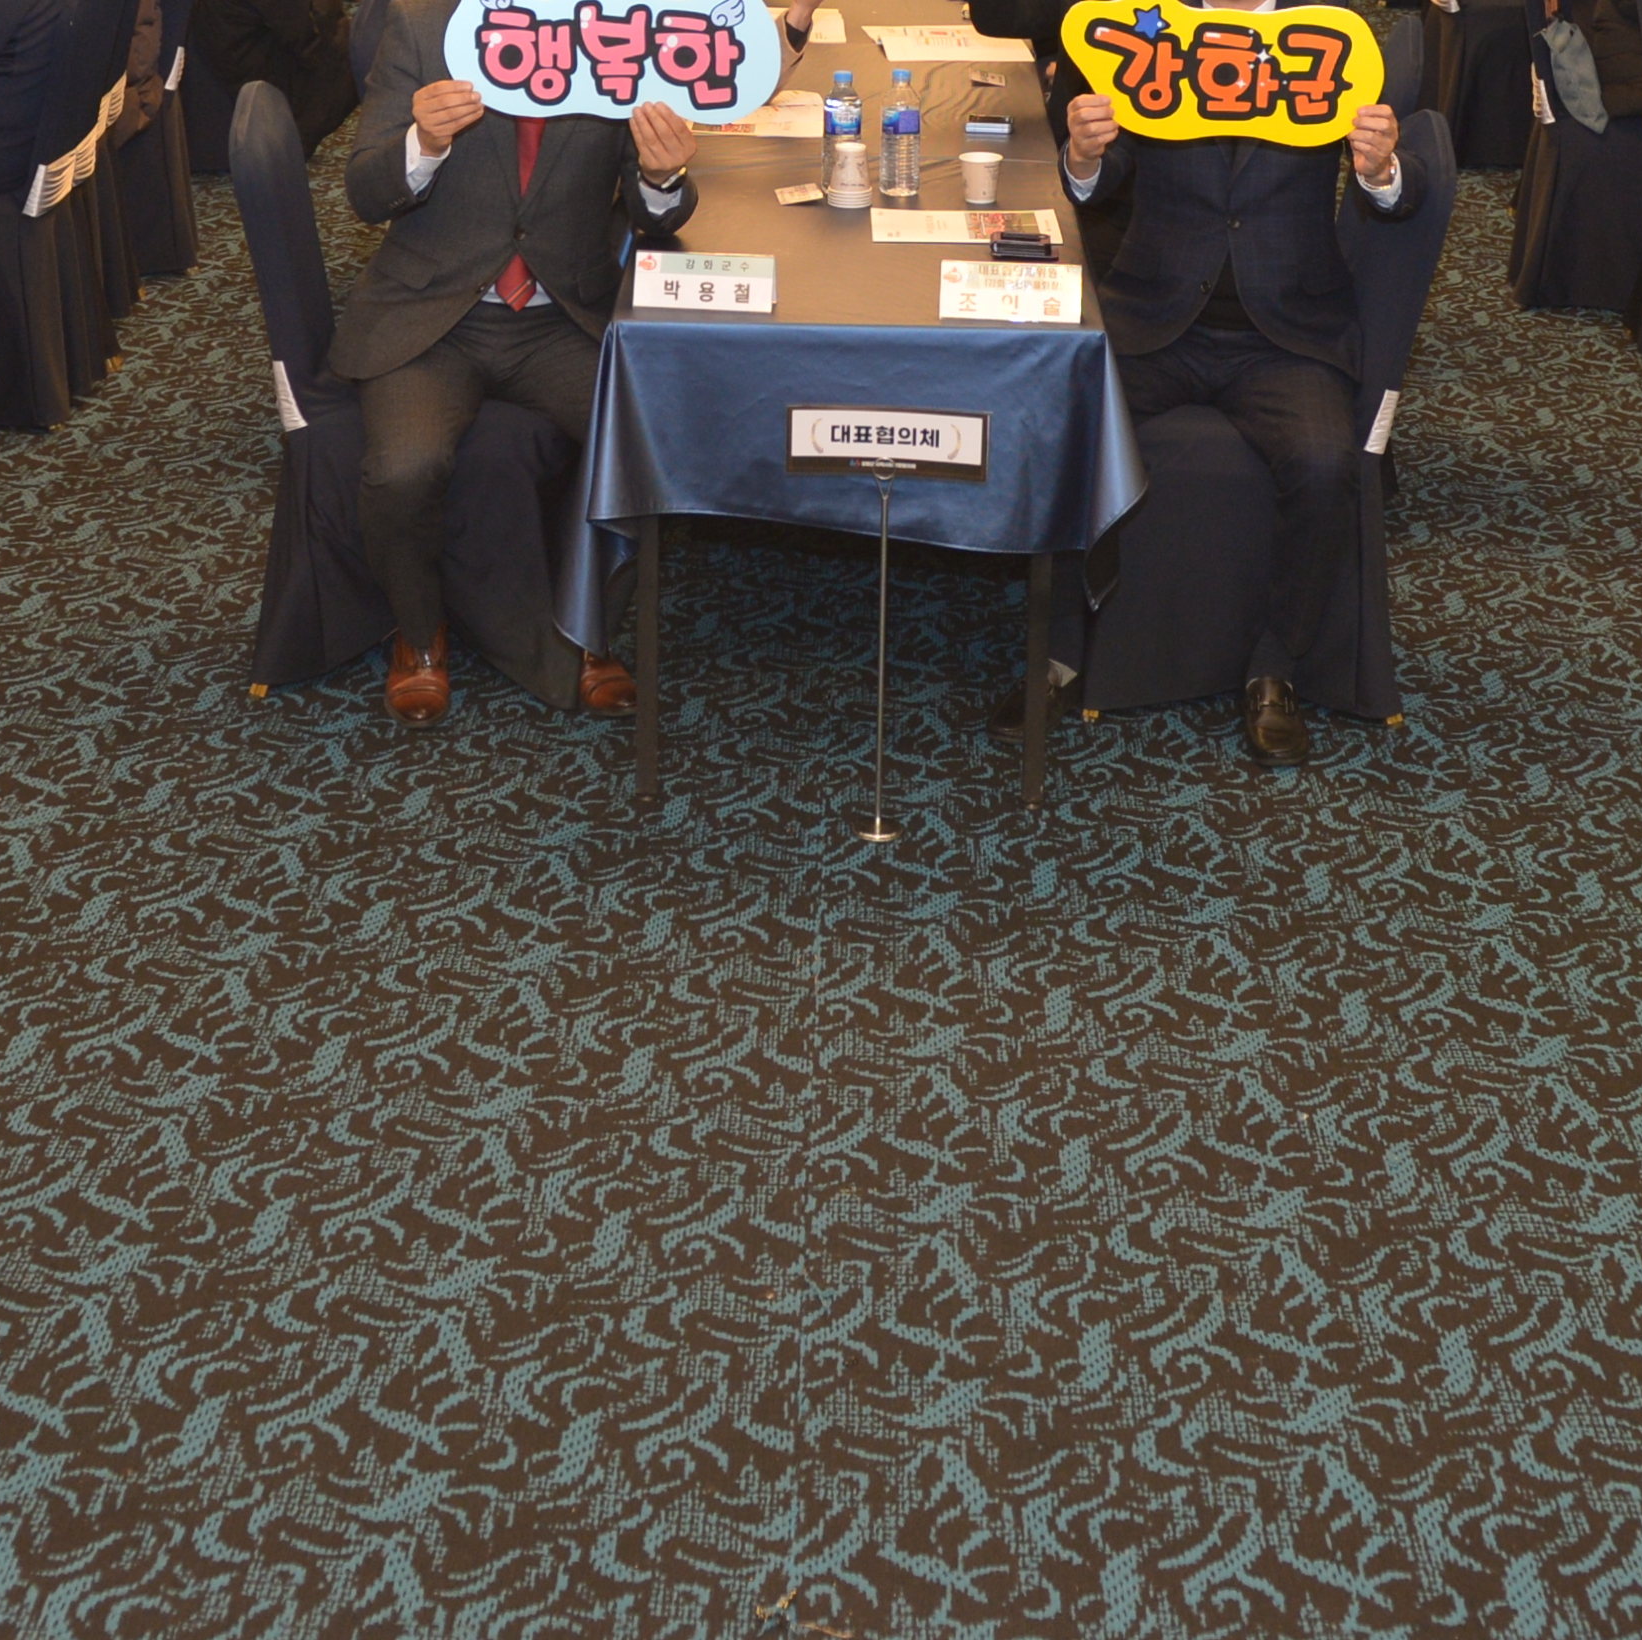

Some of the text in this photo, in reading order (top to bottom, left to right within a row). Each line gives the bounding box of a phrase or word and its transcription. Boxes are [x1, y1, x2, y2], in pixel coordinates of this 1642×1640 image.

[475, 0, 745, 110] 행복한
[1084, 18, 1353, 125] 강화군
[664, 280, 750, 304] 박용철
[831, 425, 940, 448] 대표협의체
